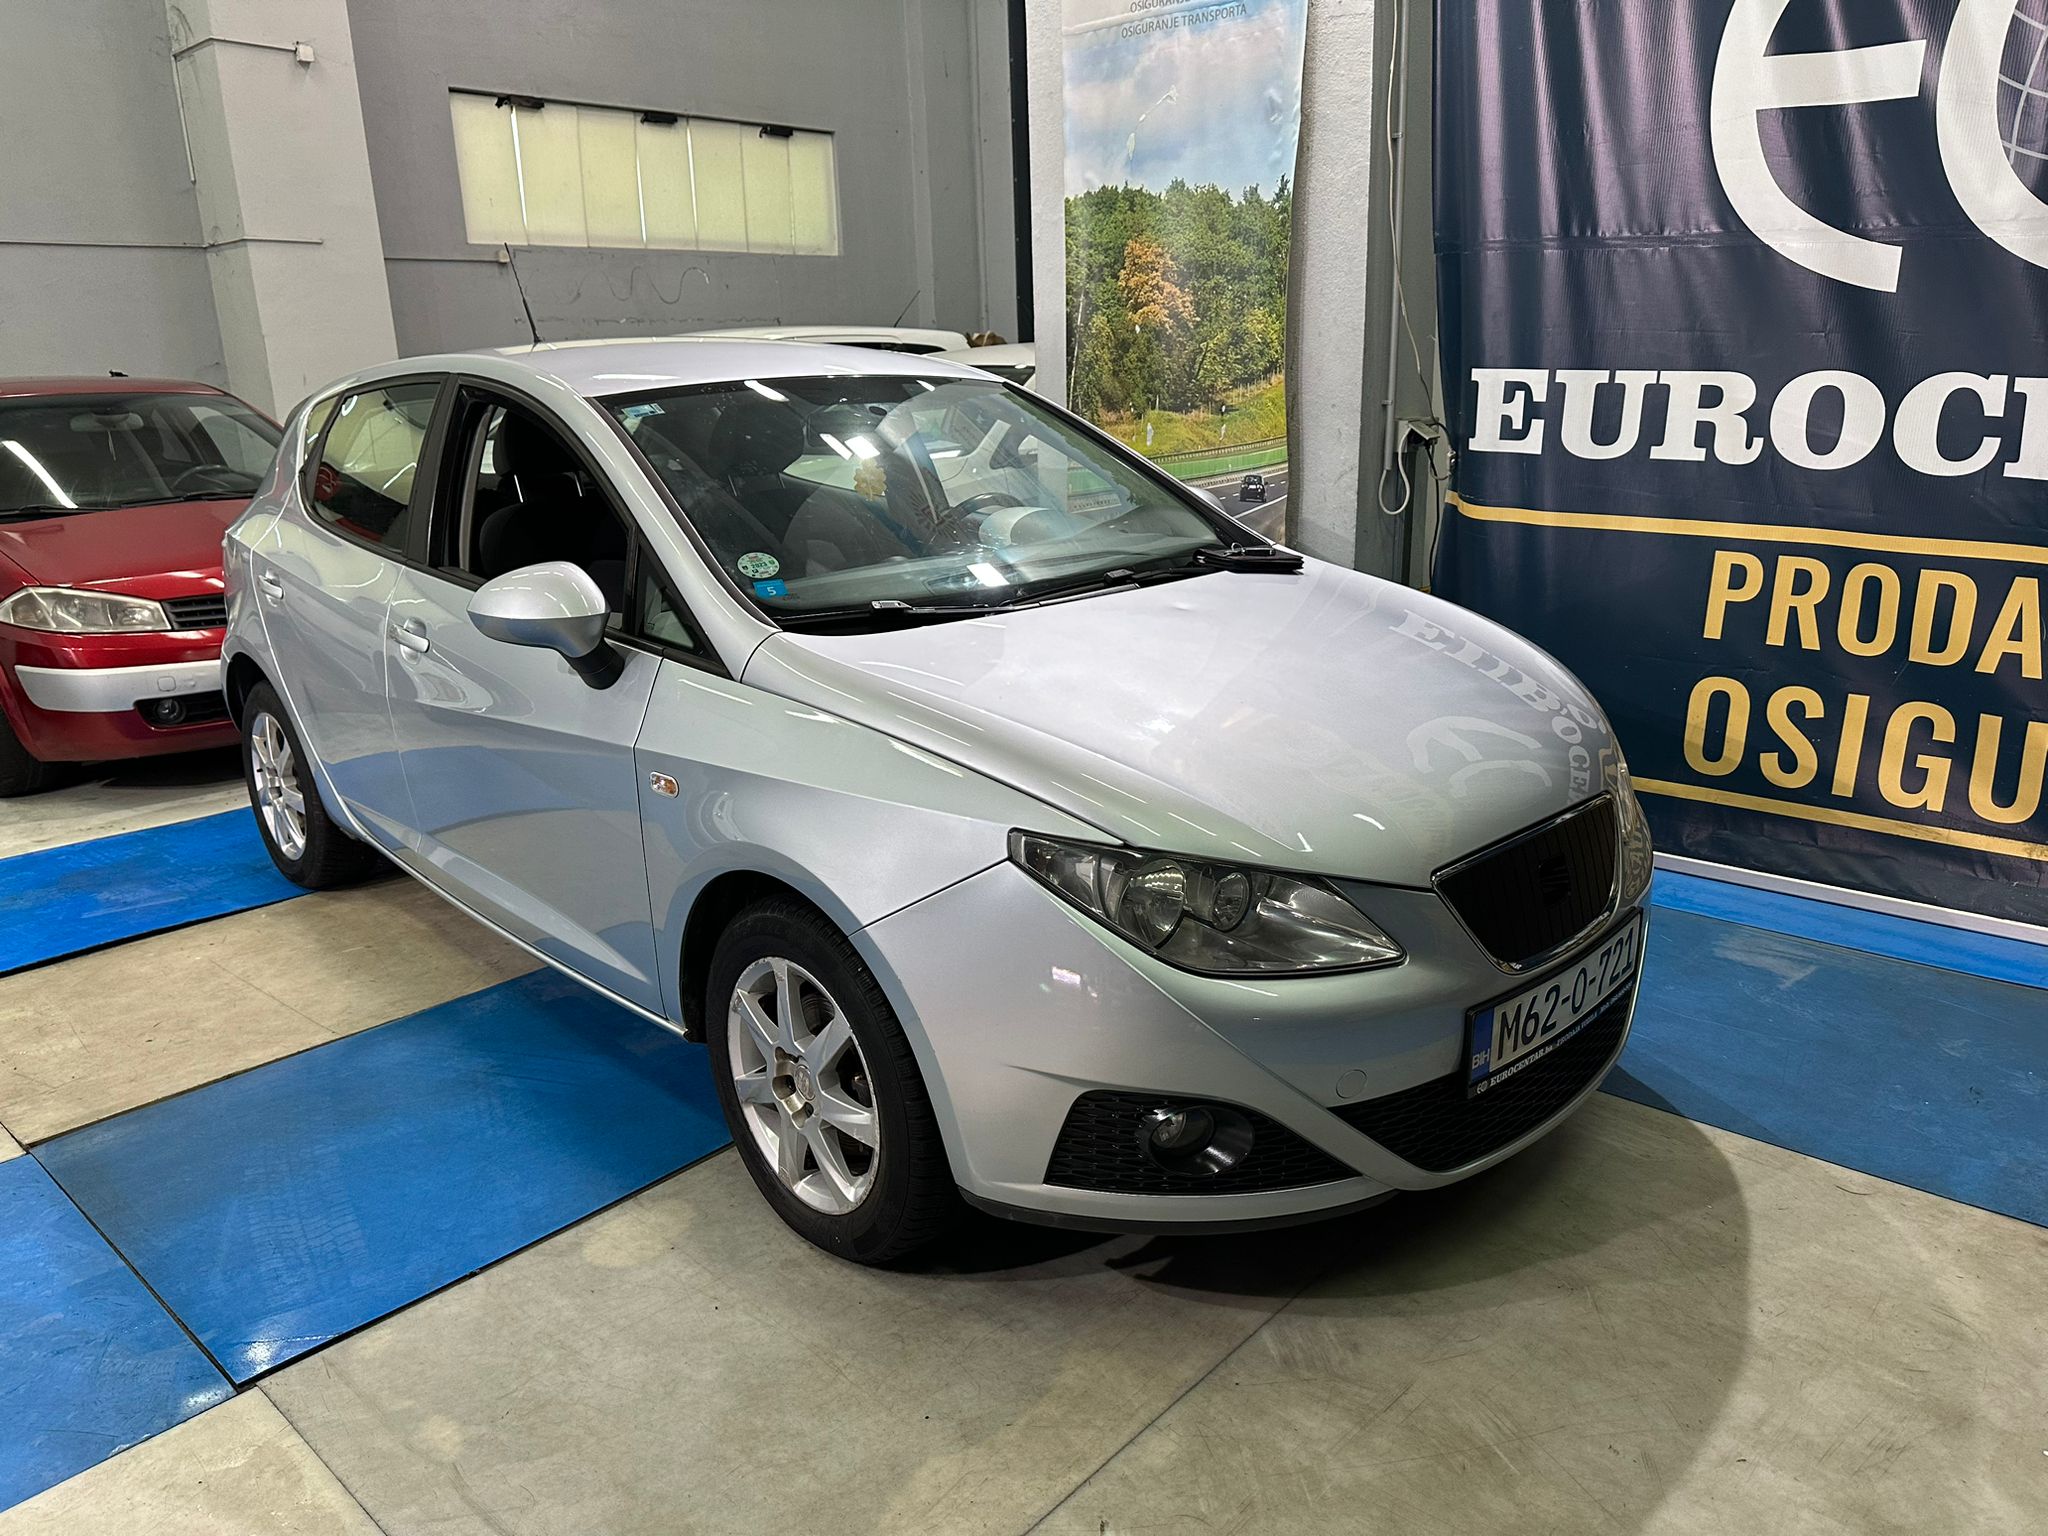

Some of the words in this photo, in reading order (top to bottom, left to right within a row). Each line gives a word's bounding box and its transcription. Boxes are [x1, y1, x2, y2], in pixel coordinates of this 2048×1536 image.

[1121, 20, 1180, 39] OSIGURANJE
[1181, 3, 1248, 26] TRANSPORTA
[766, 586, 777, 596] 5
[1702, 549, 2043, 680] PRODA
[1683, 676, 2048, 824] OSIGU
[1471, 1047, 1491, 1070] BIH
